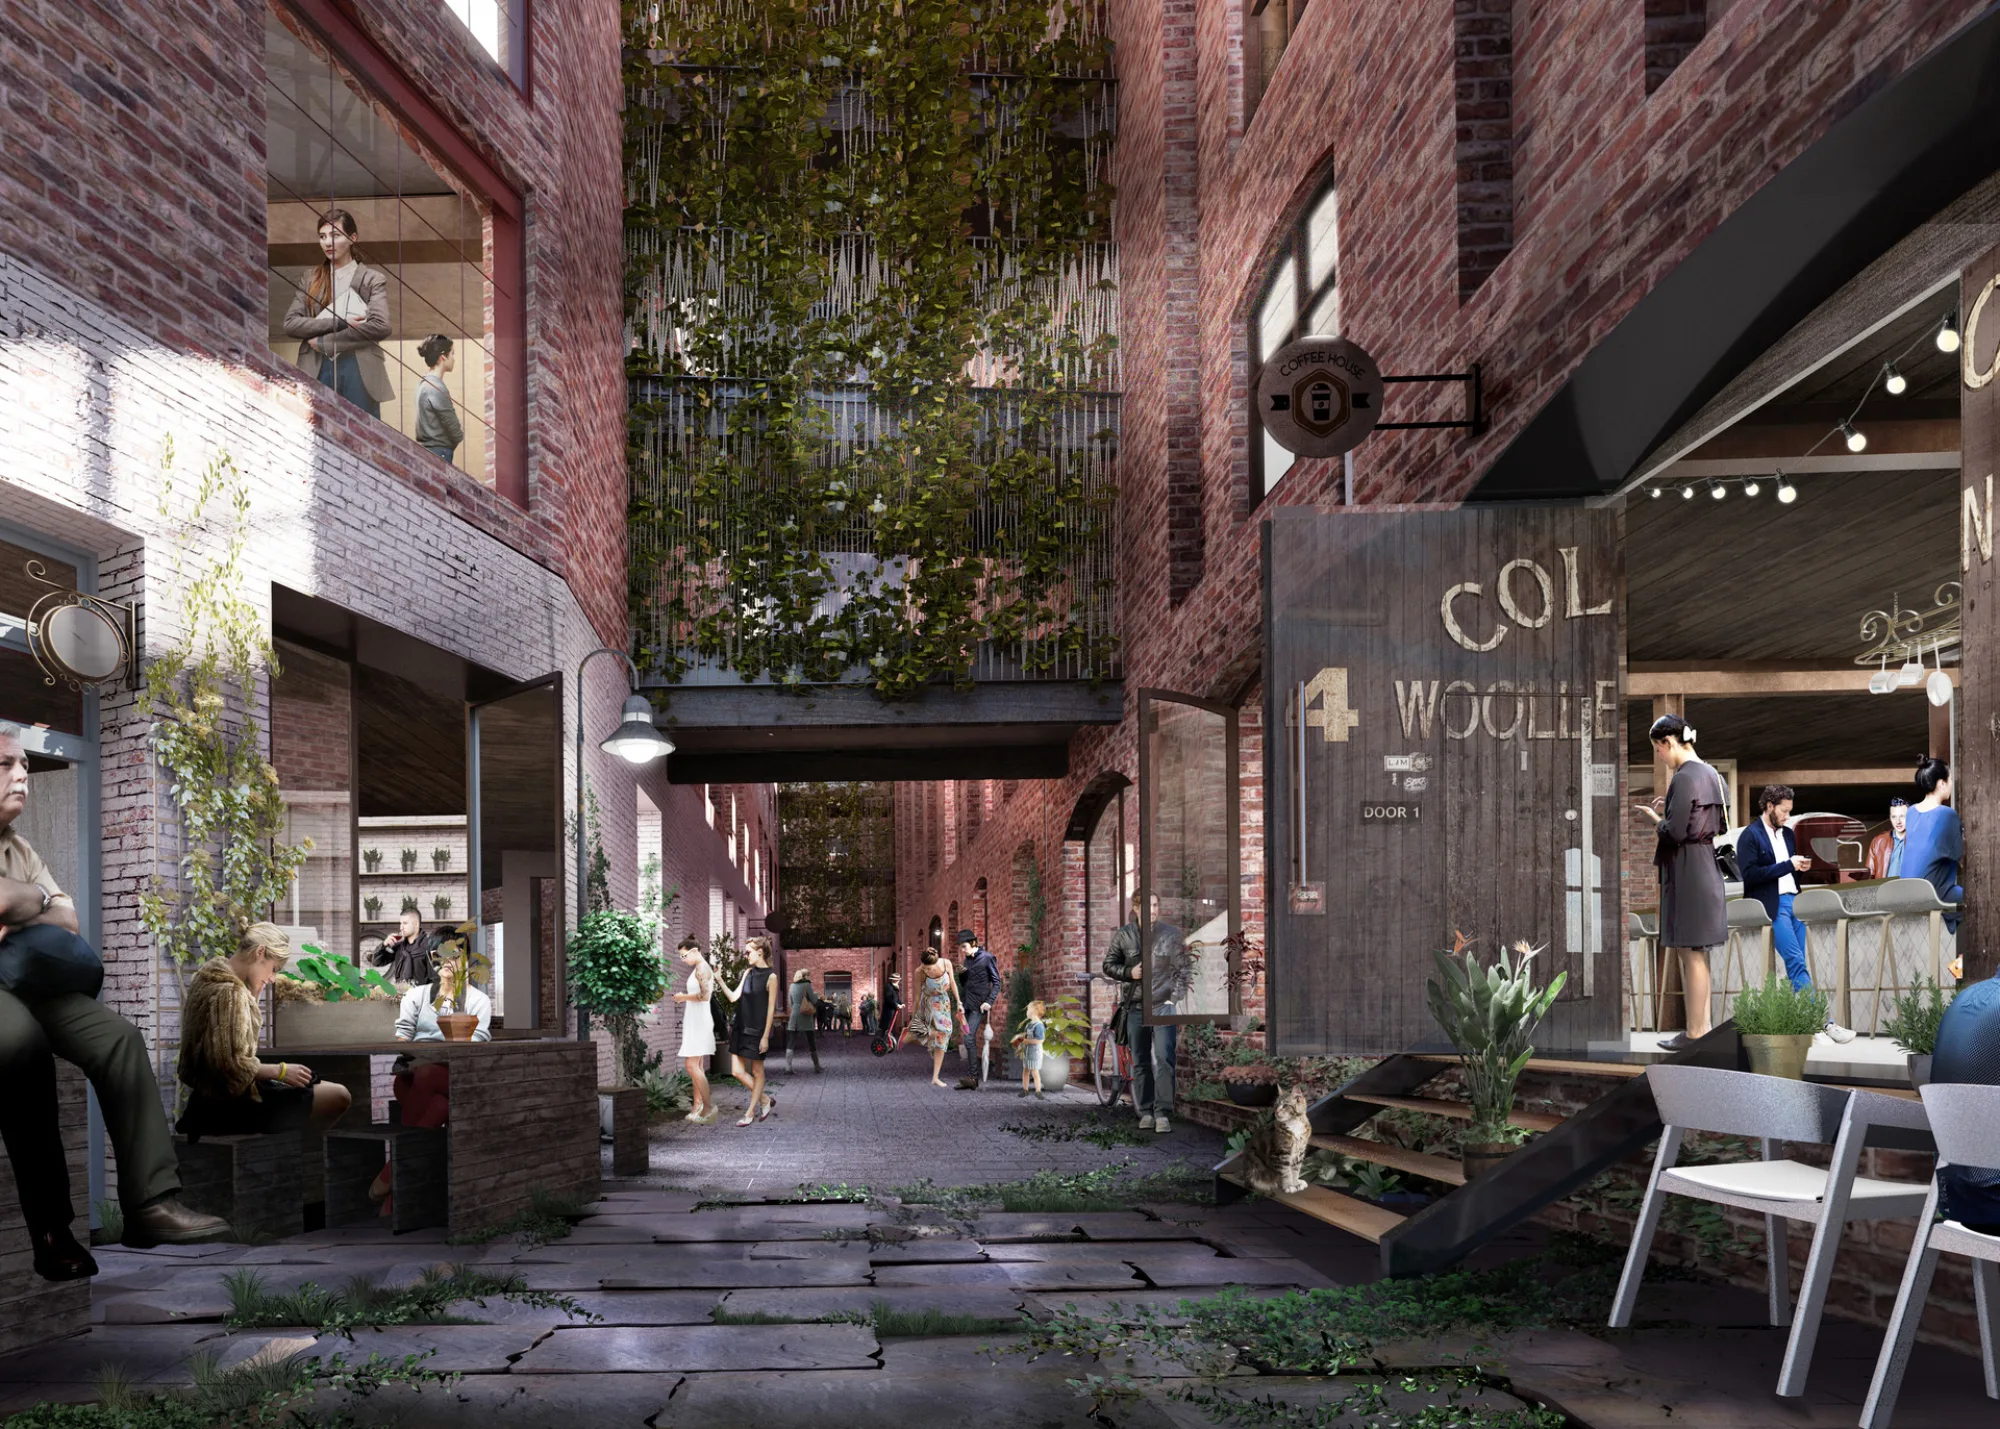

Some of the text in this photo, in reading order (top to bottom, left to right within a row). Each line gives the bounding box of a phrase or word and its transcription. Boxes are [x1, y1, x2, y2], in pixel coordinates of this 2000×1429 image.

[1280, 351, 1366, 380] COFFEE HOUSE
[1963, 473, 1994, 571] N
[1441, 546, 1613, 652] COL
[1286, 667, 1359, 742] 4
[1364, 806, 1419, 818] DOOR 1
